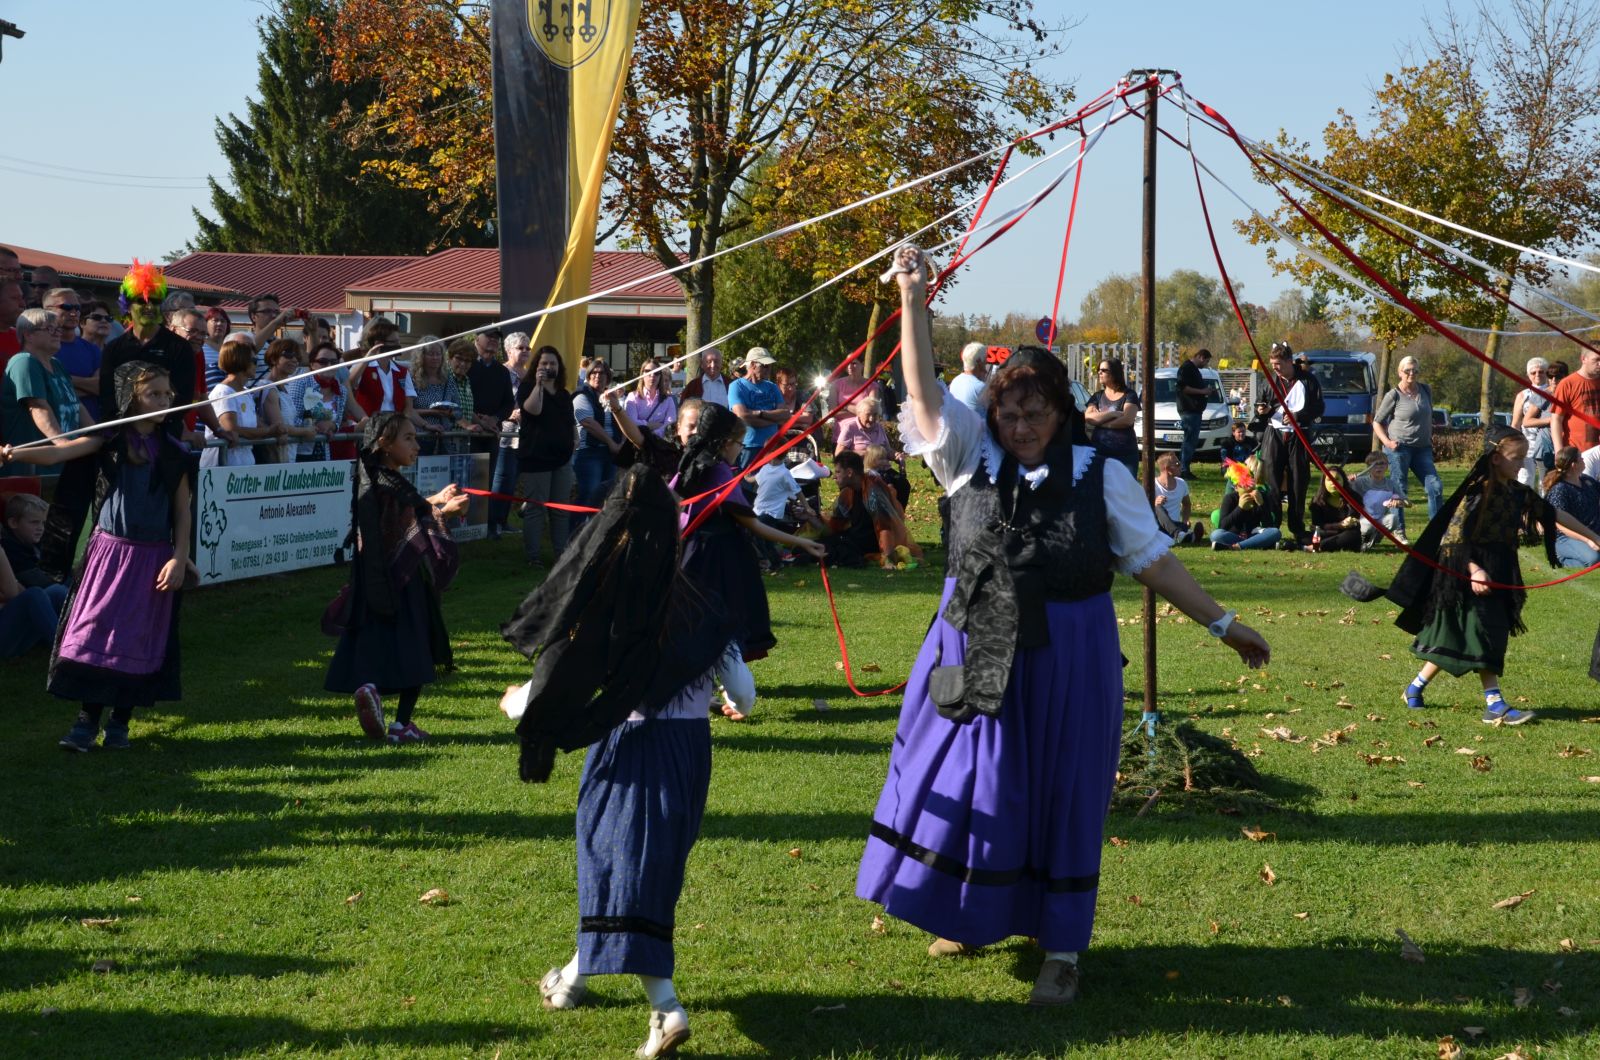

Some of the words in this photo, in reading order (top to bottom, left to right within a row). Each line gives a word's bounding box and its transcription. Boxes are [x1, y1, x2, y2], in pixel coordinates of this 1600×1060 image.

[227, 472, 261, 494] Garten-
[264, 470, 282, 492] und
[283, 467, 345, 490] Landschaftsbau
[259, 504, 285, 520] Antonio
[286, 502, 316, 518] Alexandre
[231, 539, 263, 552] Rosengasse
[273, 533, 289, 546] 74564
[243, 554, 260, 569] 07951
